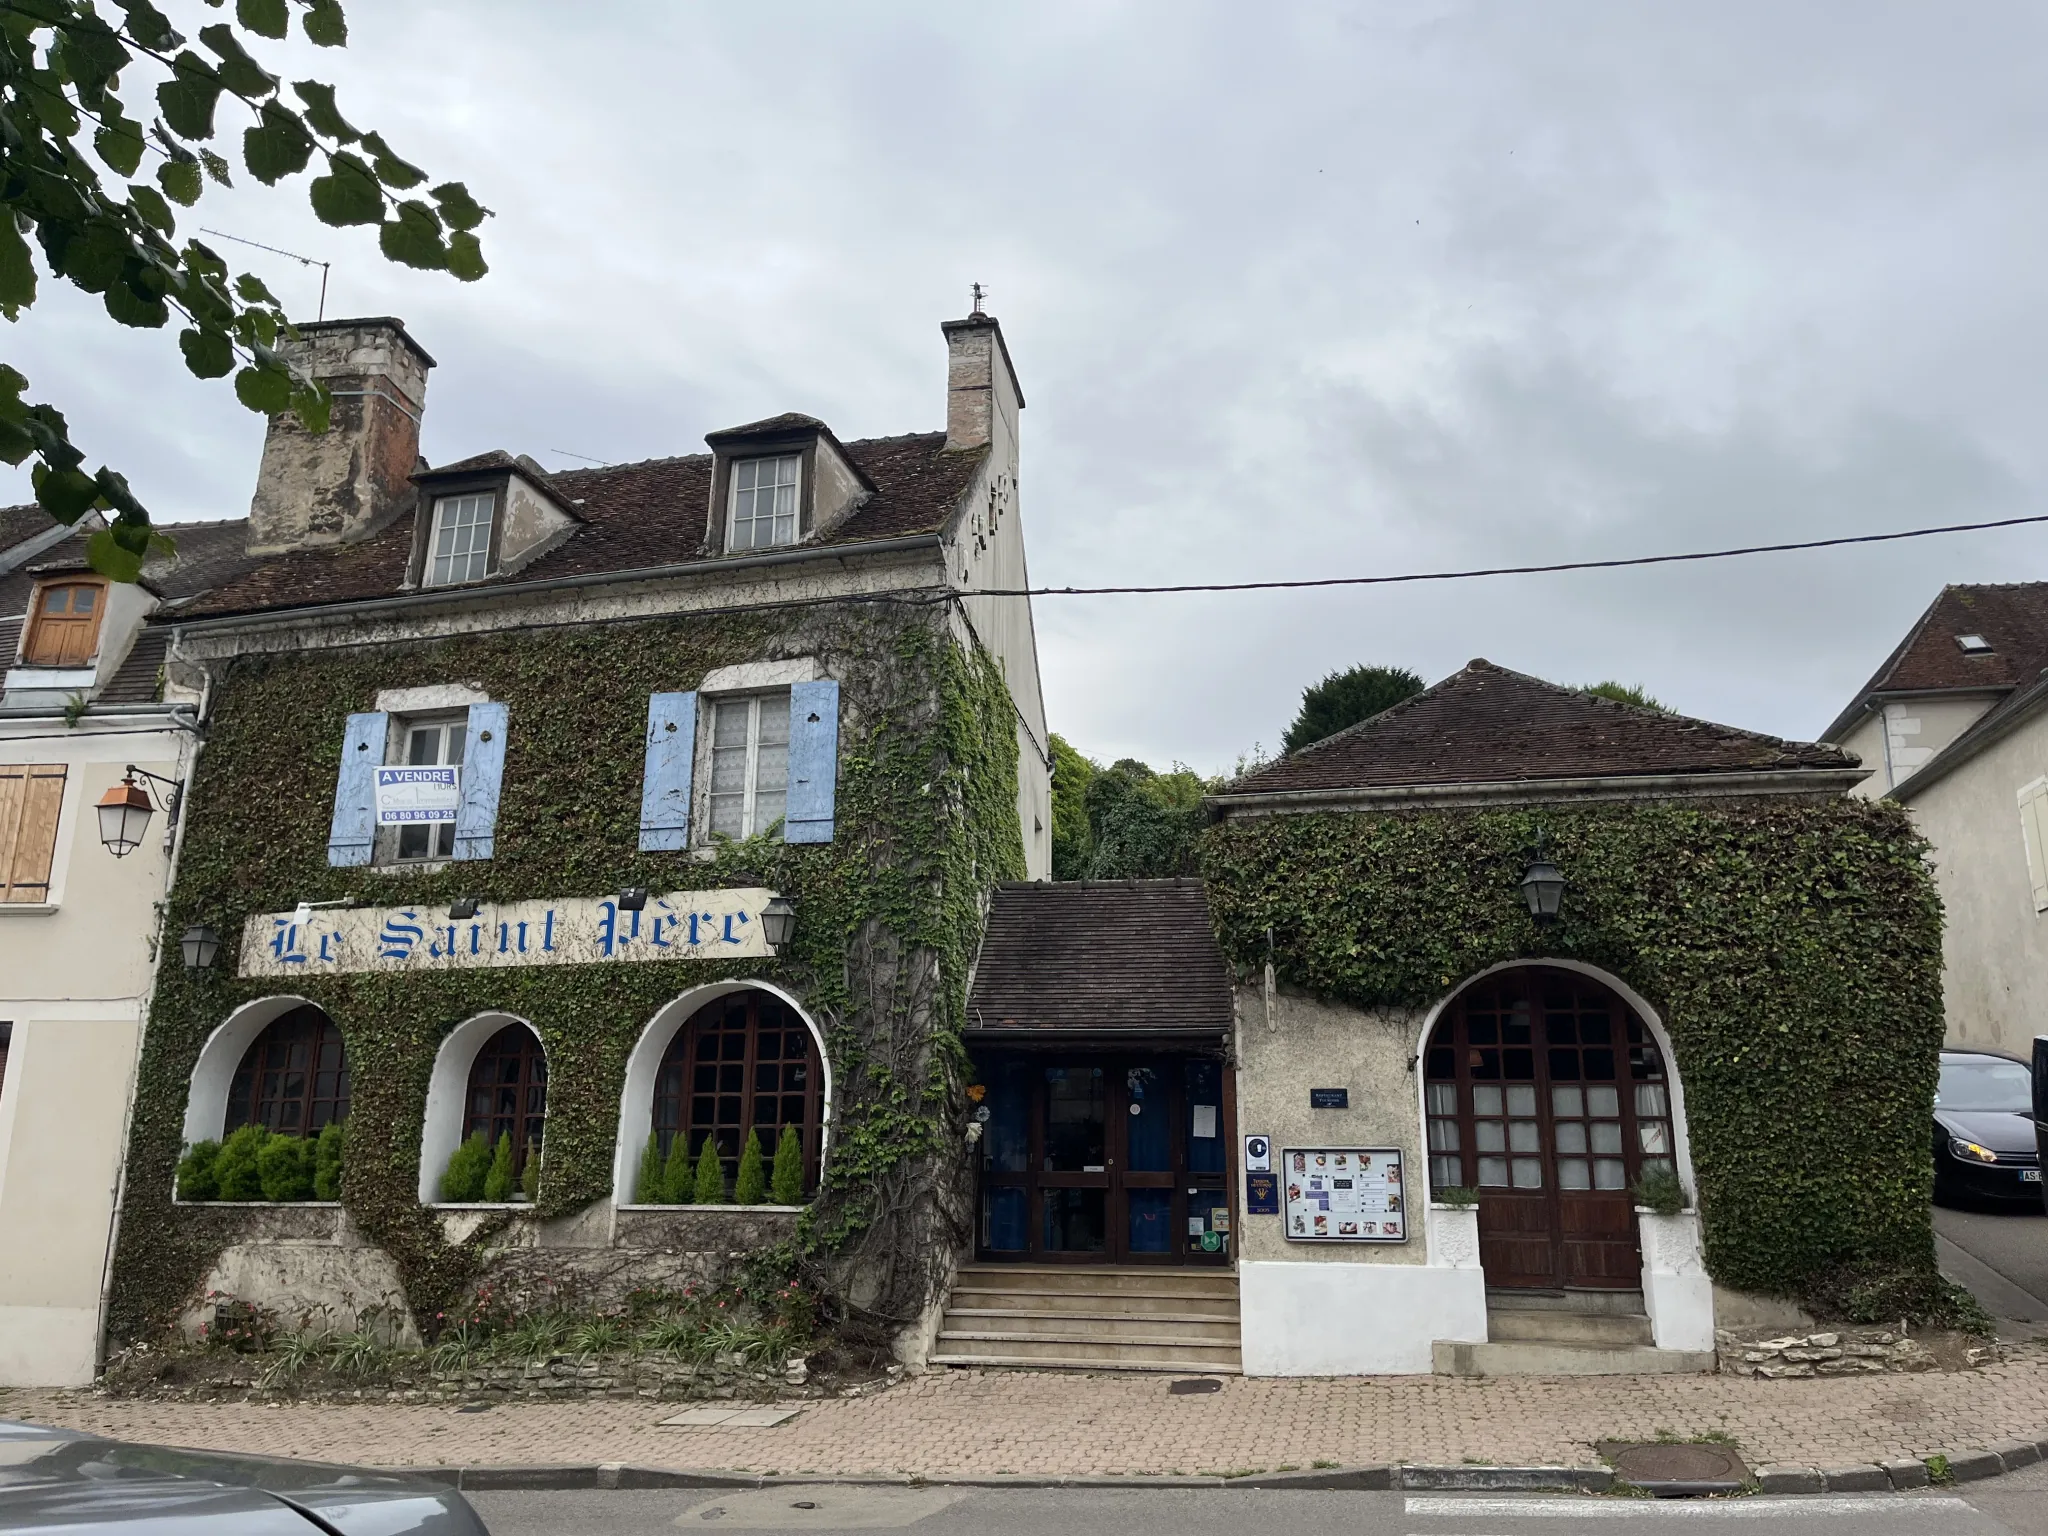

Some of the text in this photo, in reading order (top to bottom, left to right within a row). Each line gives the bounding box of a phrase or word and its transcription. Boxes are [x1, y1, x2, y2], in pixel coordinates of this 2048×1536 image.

[382, 771, 450, 782] A VENDRE
[385, 810, 455, 820] 06 80 96 09 25
[269, 899, 753, 963] Le Saint Père
